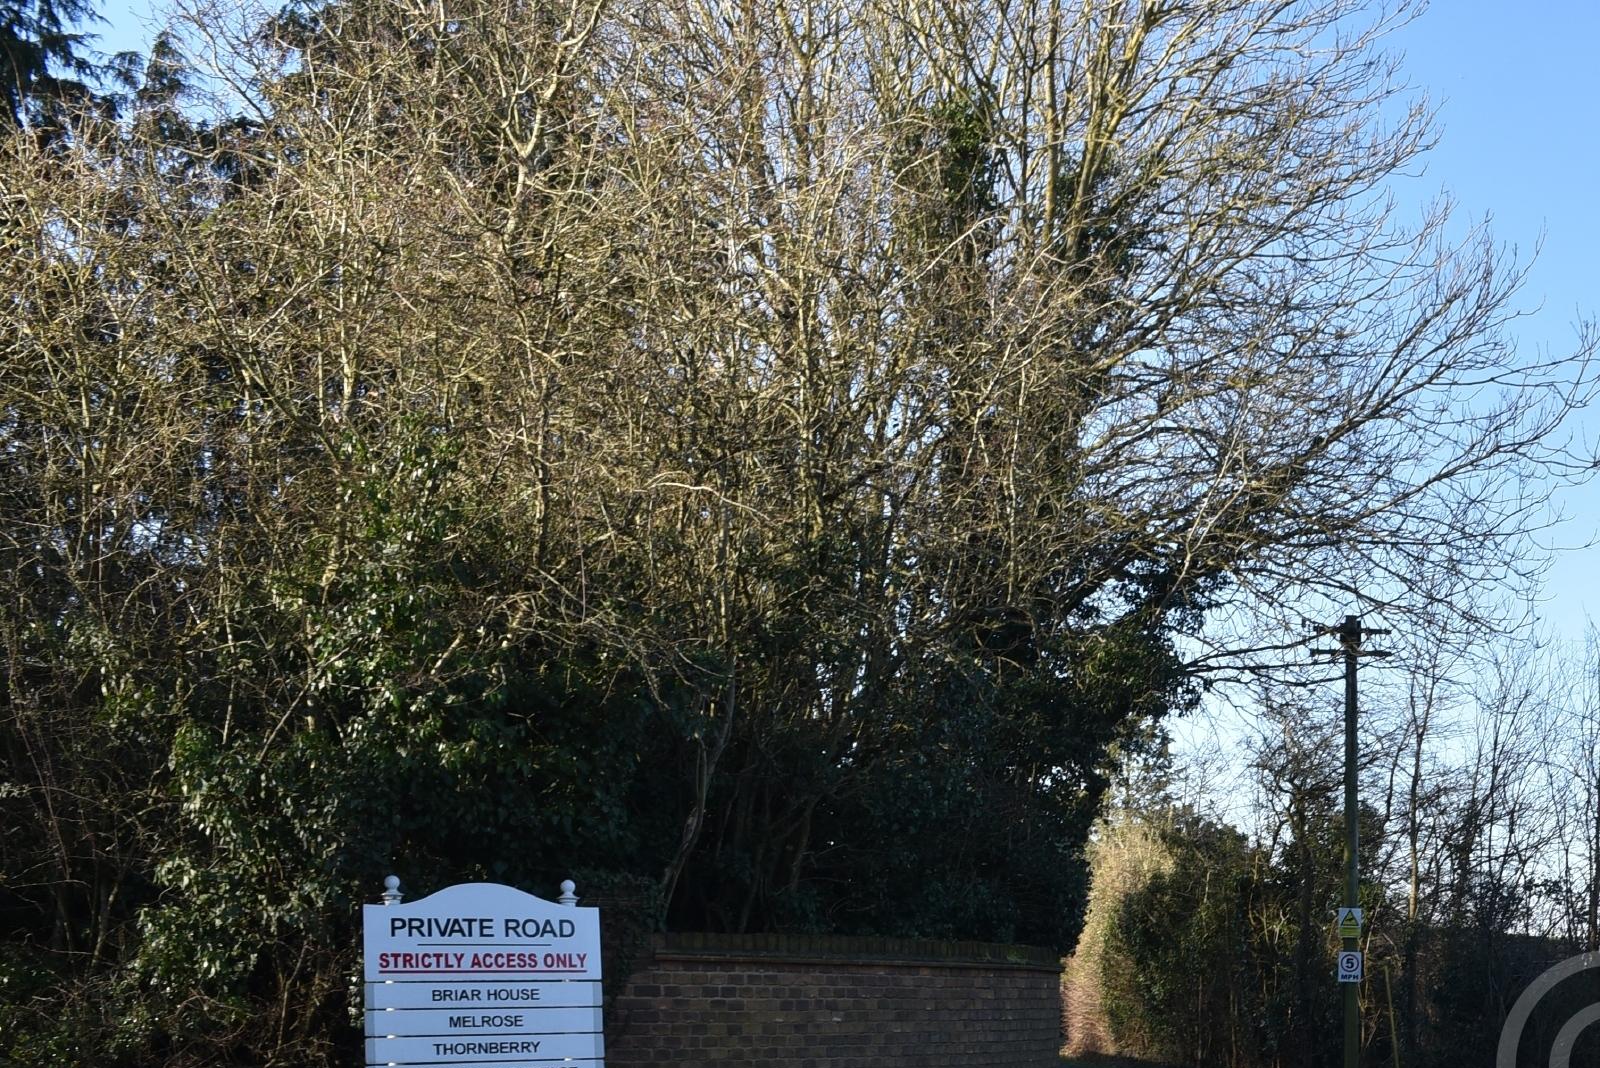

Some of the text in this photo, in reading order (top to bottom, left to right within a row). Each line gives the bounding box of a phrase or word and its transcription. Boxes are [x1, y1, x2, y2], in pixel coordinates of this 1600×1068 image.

[390, 918, 576, 938] PRIVATE ROAD
[379, 953, 587, 969] STRICTLY ACCESS ONLY
[1345, 958, 1354, 969] 5
[432, 988, 540, 1002] BRIAR HOUSE
[449, 1015, 524, 1028] MELROSE
[433, 1041, 541, 1056] THORNBERRY
